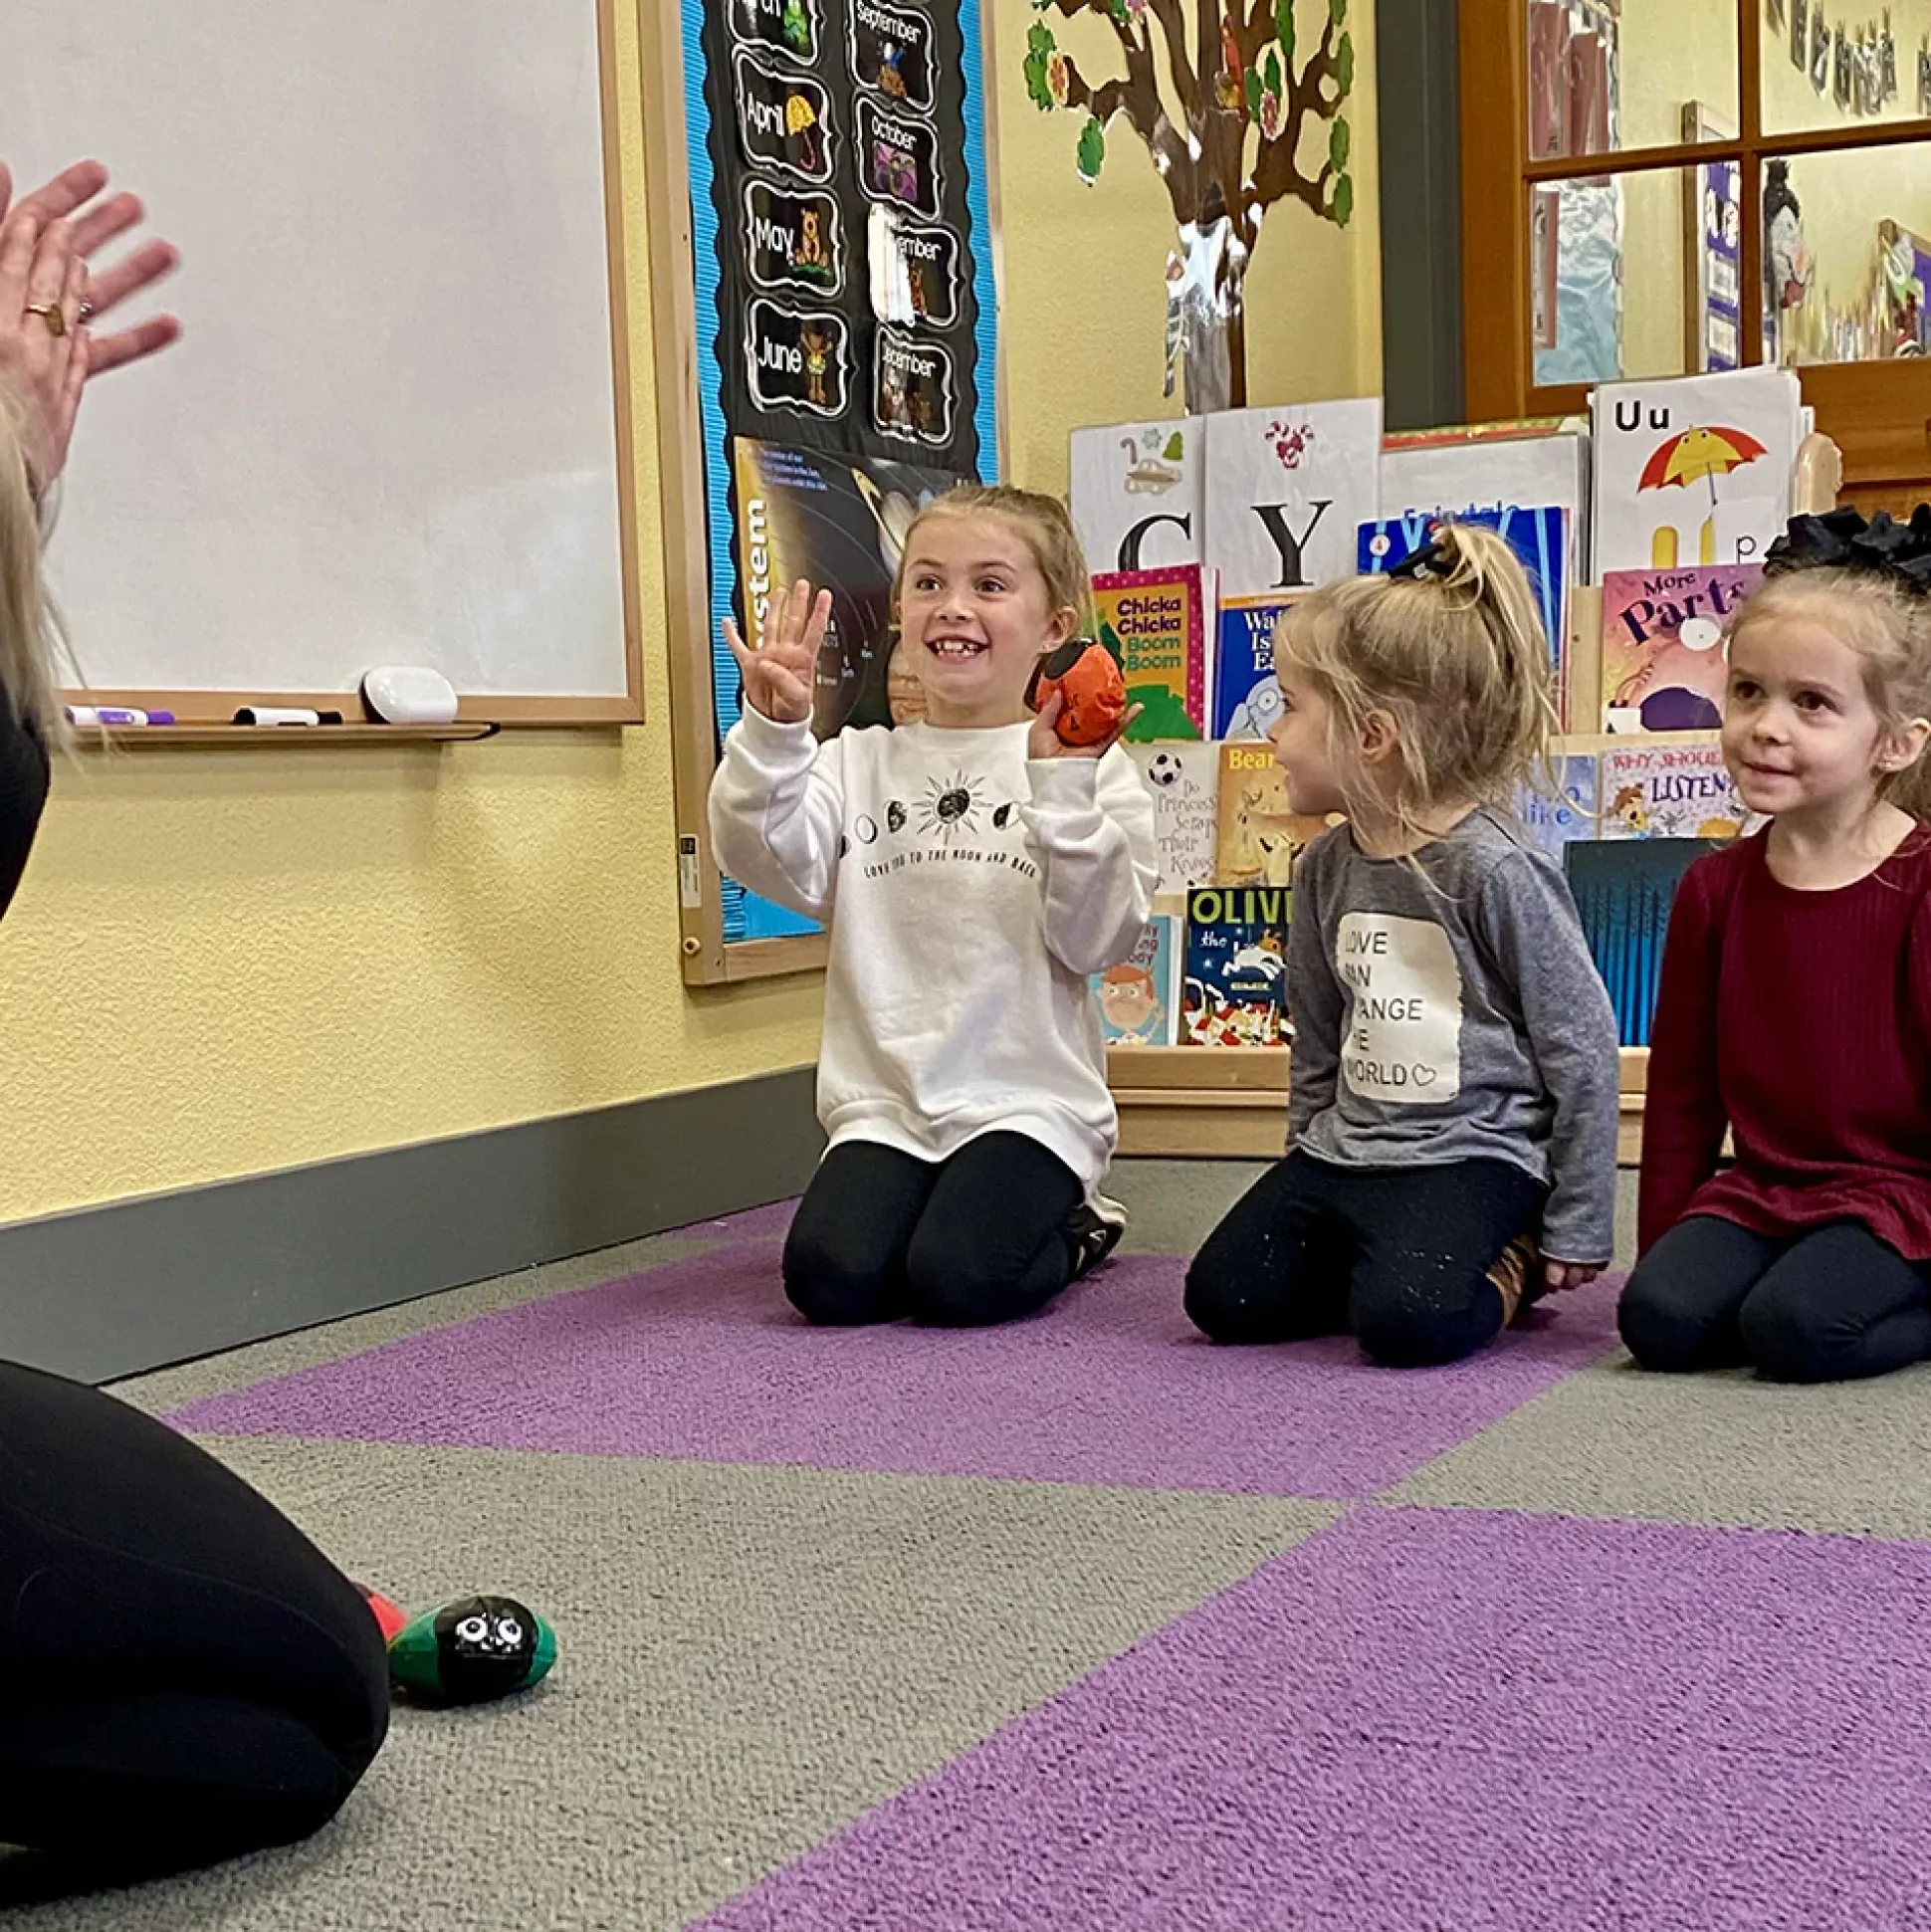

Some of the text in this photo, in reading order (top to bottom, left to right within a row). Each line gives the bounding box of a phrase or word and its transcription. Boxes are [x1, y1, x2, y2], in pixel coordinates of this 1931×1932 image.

[857, 1, 922, 43] September
[748, 92, 785, 137] April
[871, 114, 918, 150] October
[755, 217, 795, 267] May
[897, 235, 942, 261] ember
[758, 335, 802, 373] June
[1250, 500, 1334, 588] Y
[747, 500, 770, 649] stem
[1642, 572, 1696, 597] More
[1117, 595, 1181, 615] Chicka
[1117, 615, 1181, 635] Chicka
[1128, 636, 1180, 652] Boom
[1252, 631, 1272, 651] Is
[1126, 653, 1180, 671] Boom
[1357, 996, 1423, 1021] ANGE
